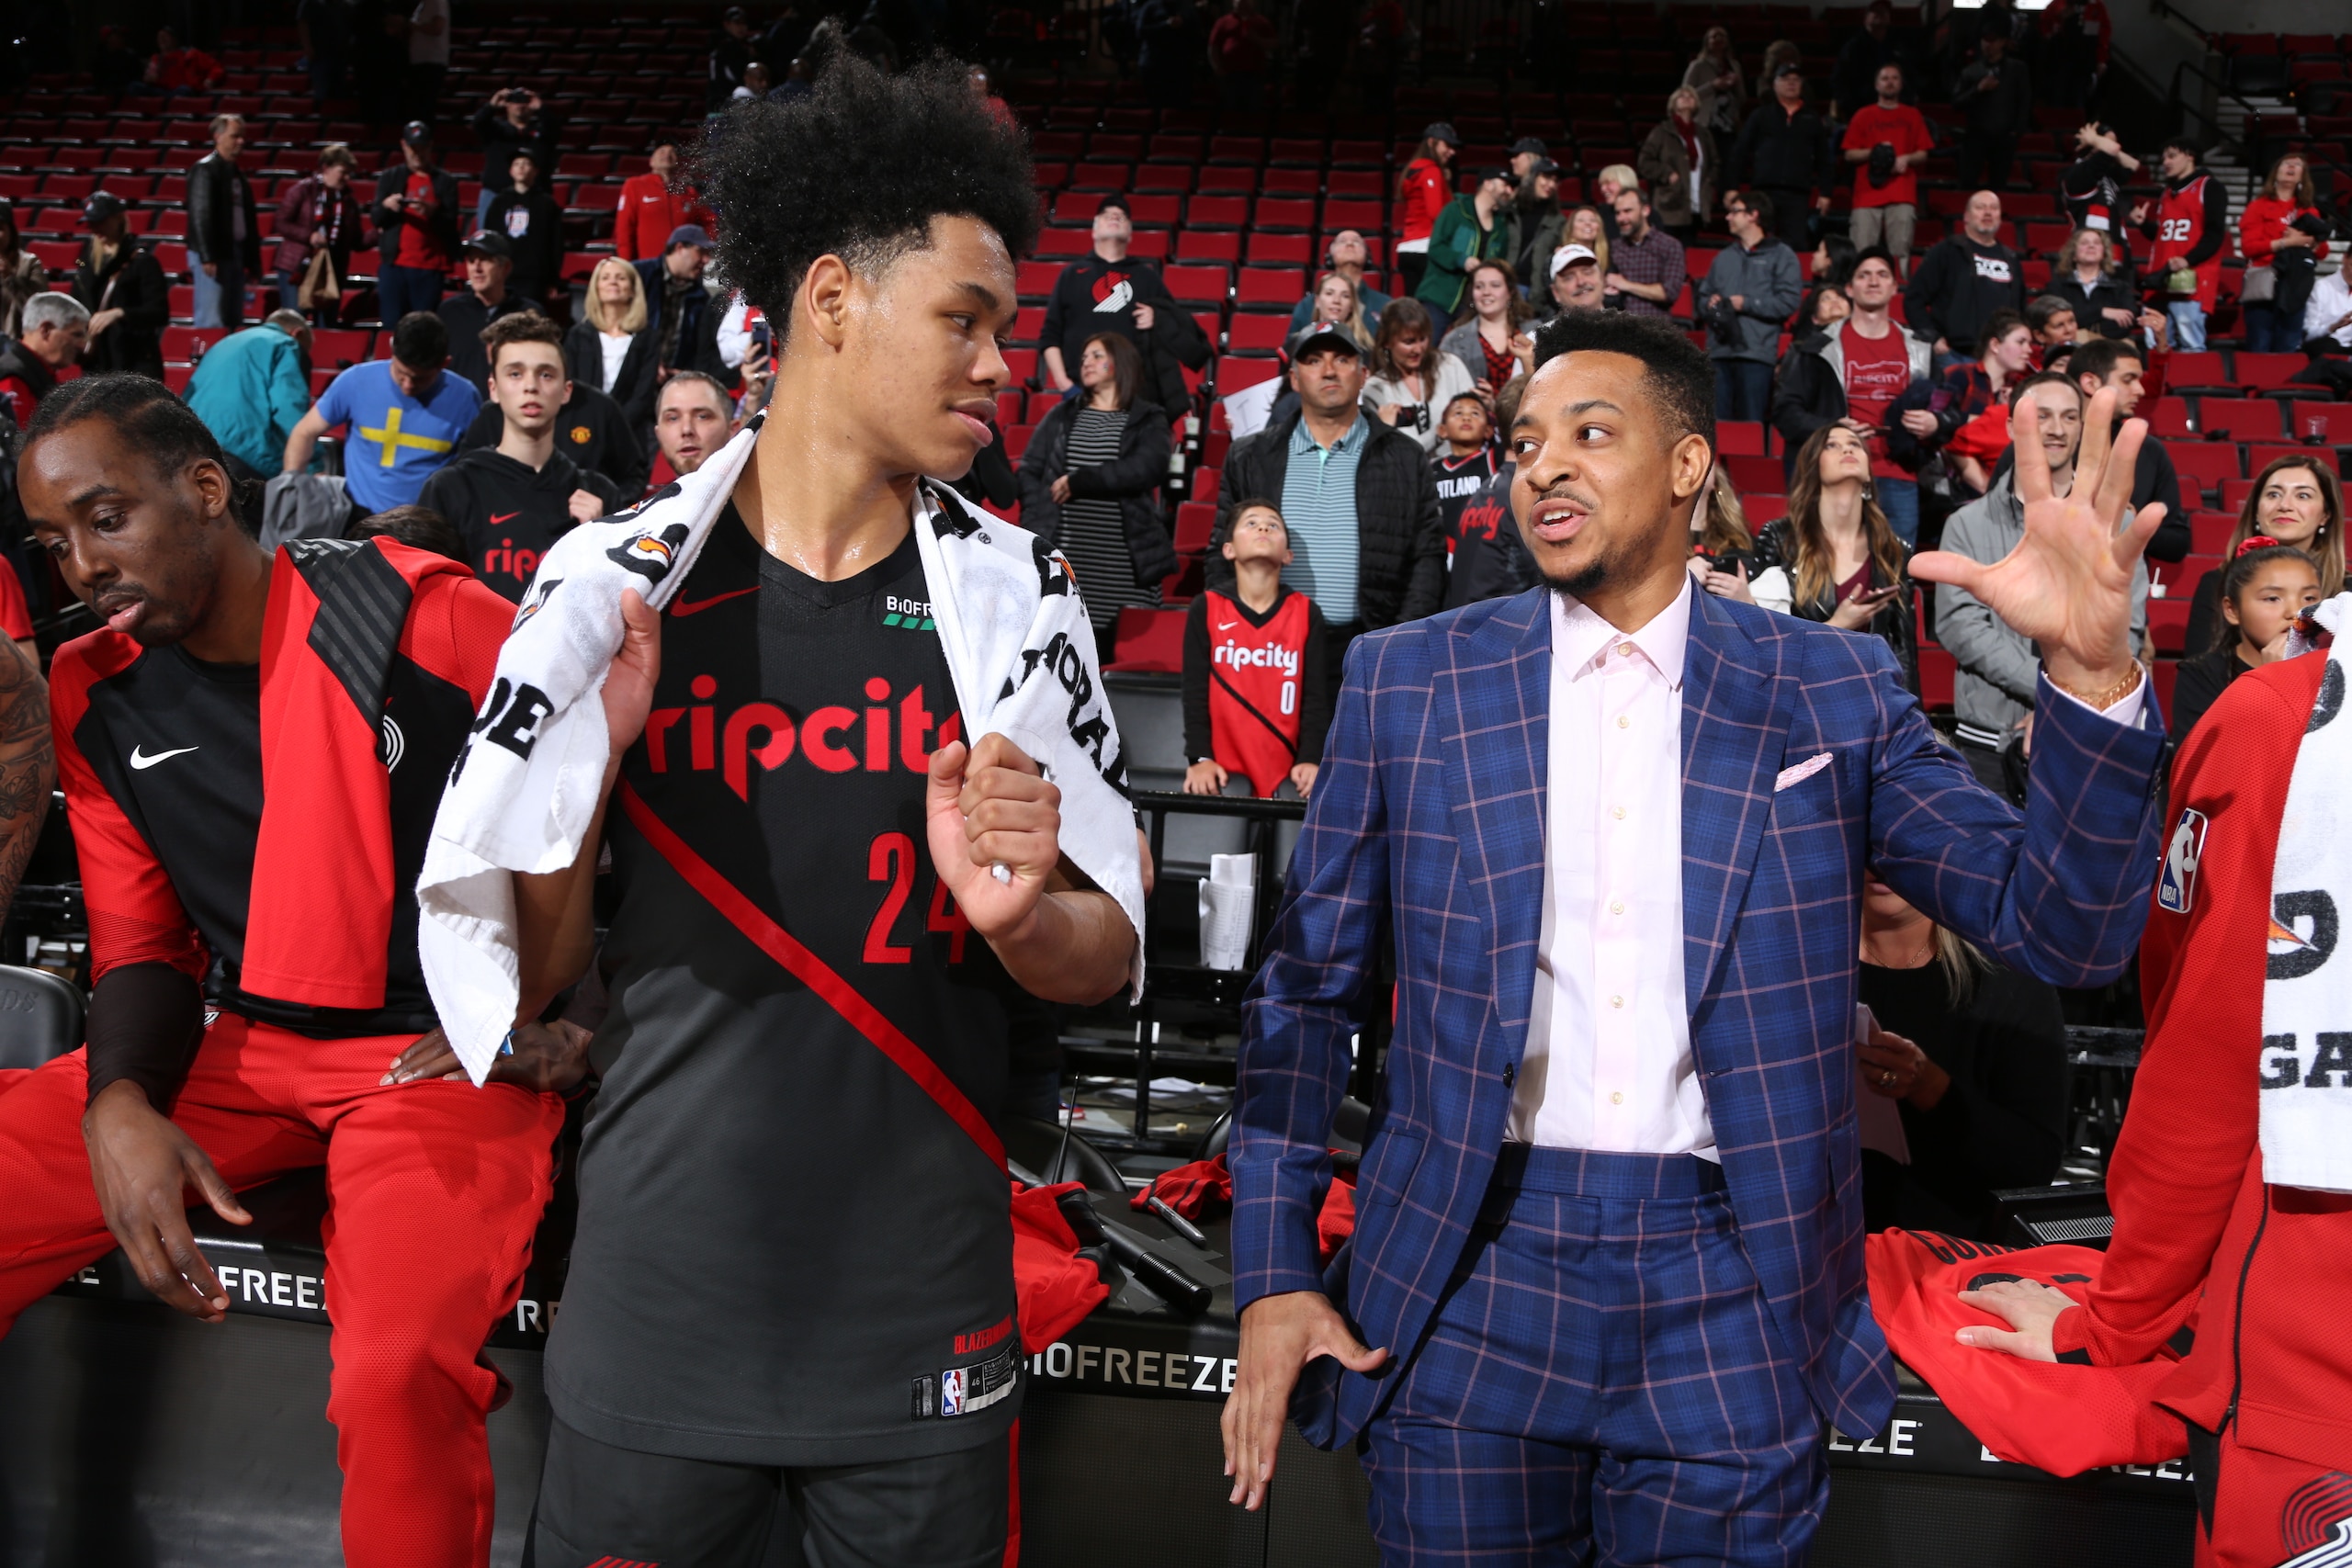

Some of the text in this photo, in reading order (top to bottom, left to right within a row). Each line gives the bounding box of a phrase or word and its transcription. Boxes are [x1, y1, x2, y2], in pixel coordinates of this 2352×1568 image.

[2161, 219, 2192, 242] 32
[485, 538, 550, 582] rip
[1215, 638, 1298, 676] ripcity
[1280, 681, 1296, 715] 0
[2161, 883, 2177, 905] NBA
[1023, 1342, 1237, 1393] IOFREEZE
